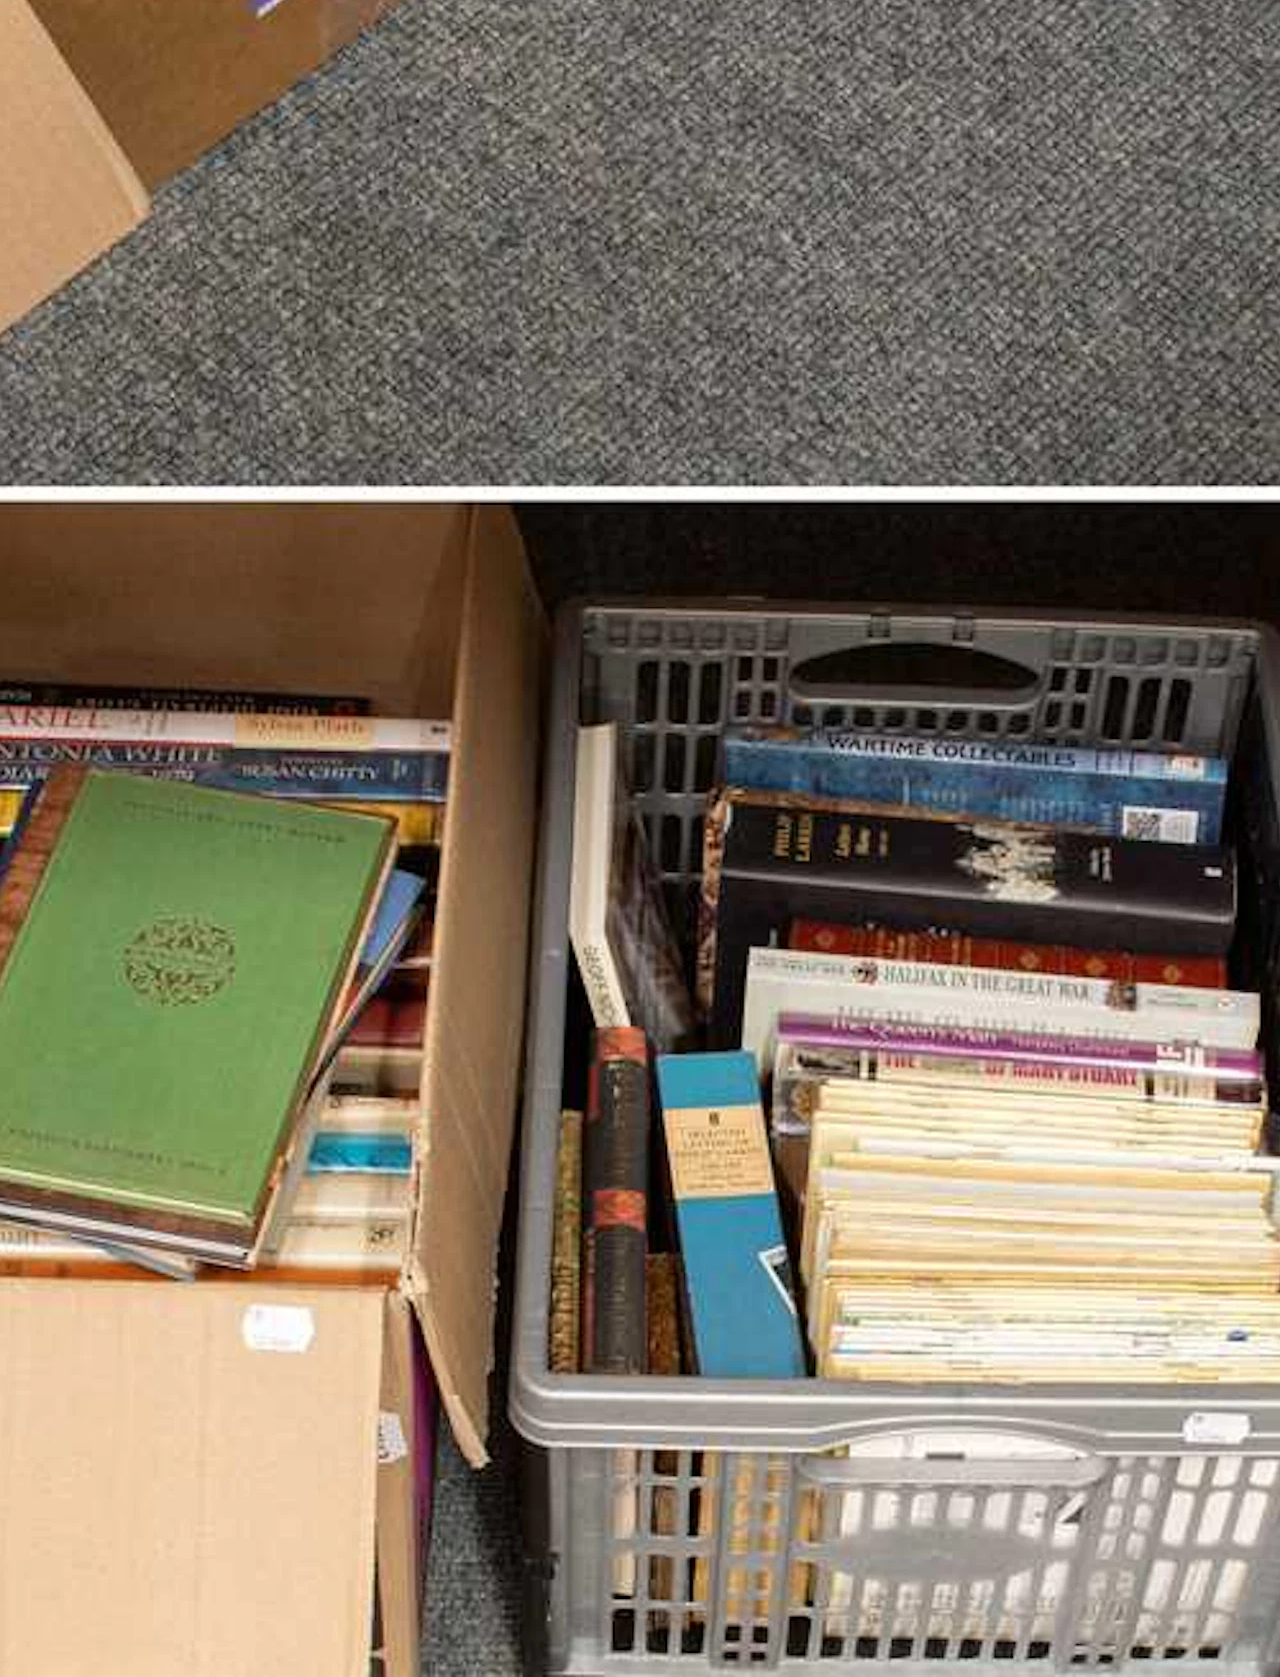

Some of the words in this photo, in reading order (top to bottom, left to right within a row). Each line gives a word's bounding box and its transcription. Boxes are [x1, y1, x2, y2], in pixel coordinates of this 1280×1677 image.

[119, 743, 220, 765] WHITE
[827, 734, 928, 760] WARTIME
[931, 741, 1077, 768] COLLECTABLES
[882, 963, 948, 989] HALIFAX
[948, 971, 968, 990] IN
[971, 972, 999, 993] THE
[1000, 975, 1054, 998] GREAT
[1057, 979, 1093, 1002] WAR
